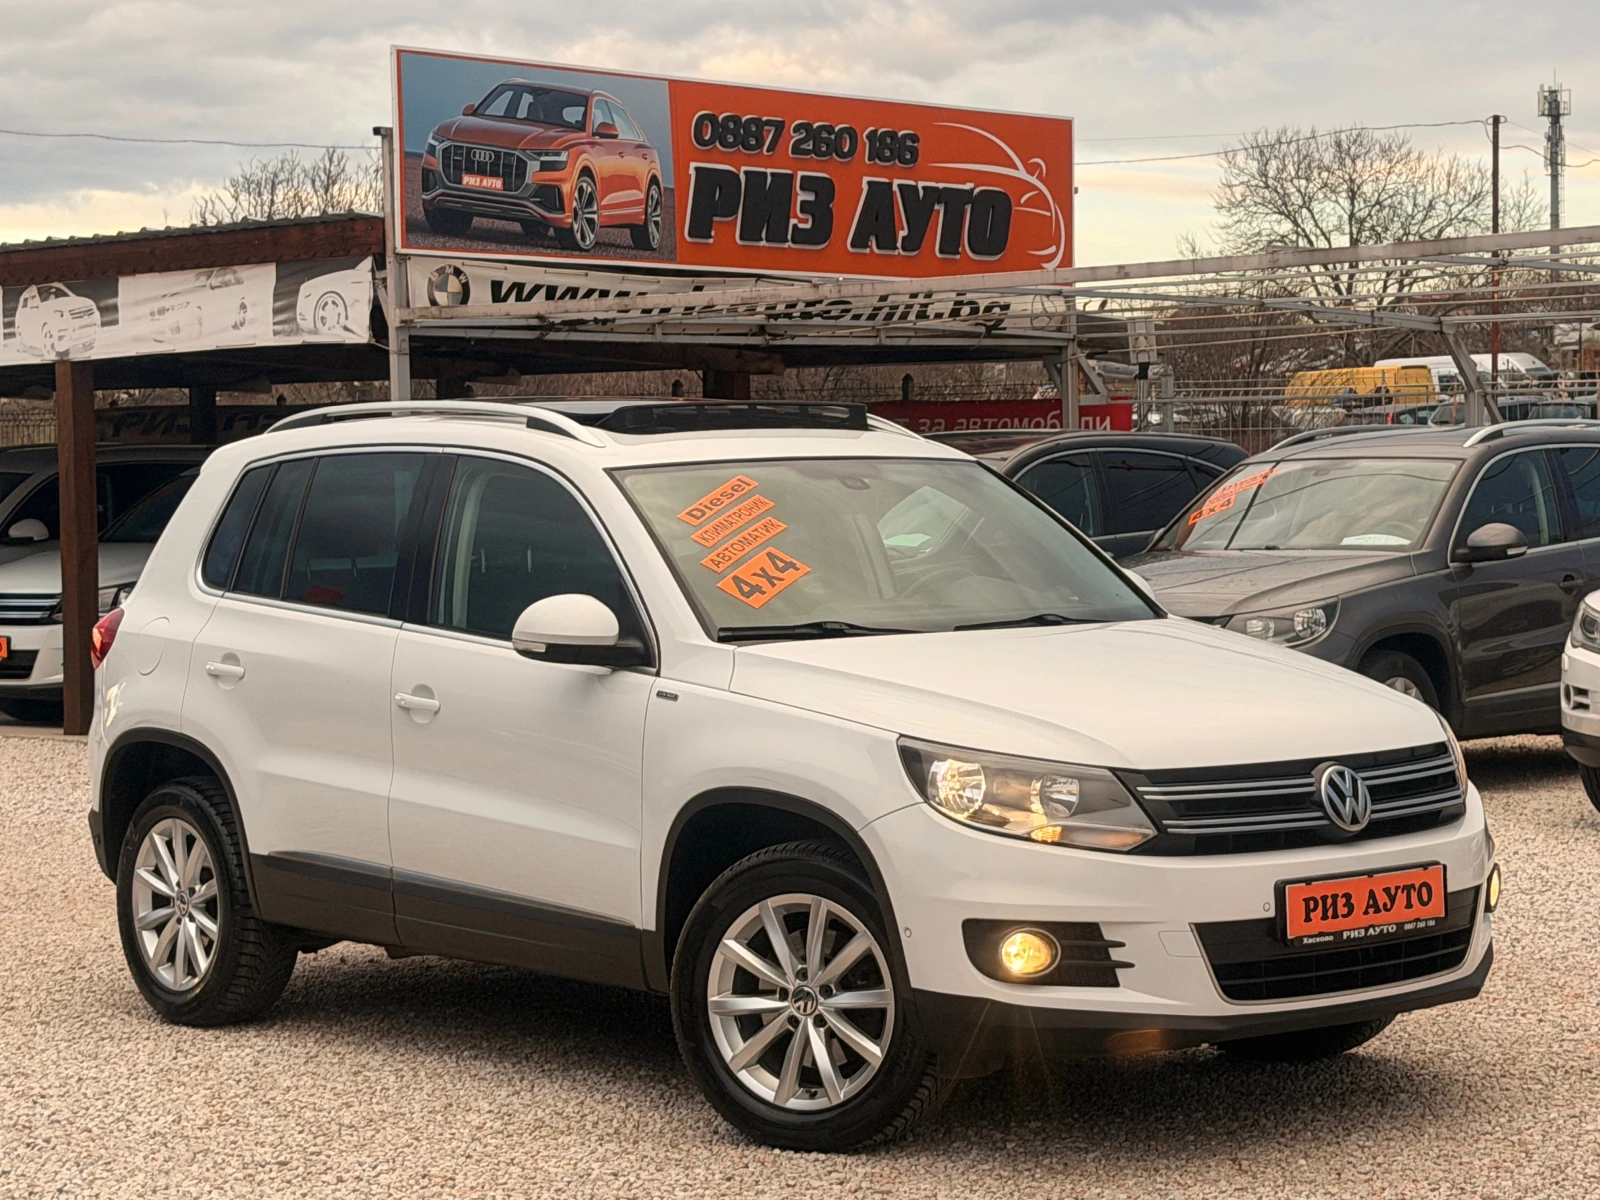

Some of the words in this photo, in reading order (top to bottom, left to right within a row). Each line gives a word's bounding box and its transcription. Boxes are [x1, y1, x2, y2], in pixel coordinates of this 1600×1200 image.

[692, 111, 785, 155] 0887
[789, 120, 858, 162] 260
[864, 127, 920, 167] 186
[685, 162, 836, 250] РИЗ
[847, 176, 1013, 260] АУТО
[953, 410, 1111, 431] автомобли
[685, 478, 752, 521] Diesel
[697, 497, 768, 543] КЛИМАТРОНИК
[709, 519, 781, 569] АВТОМАТИК
[1302, 891, 1355, 923] РИЗ
[1363, 881, 1433, 916] АУТО
[1342, 929, 1366, 940] РИЗ
[1366, 923, 1397, 936] АУТО
